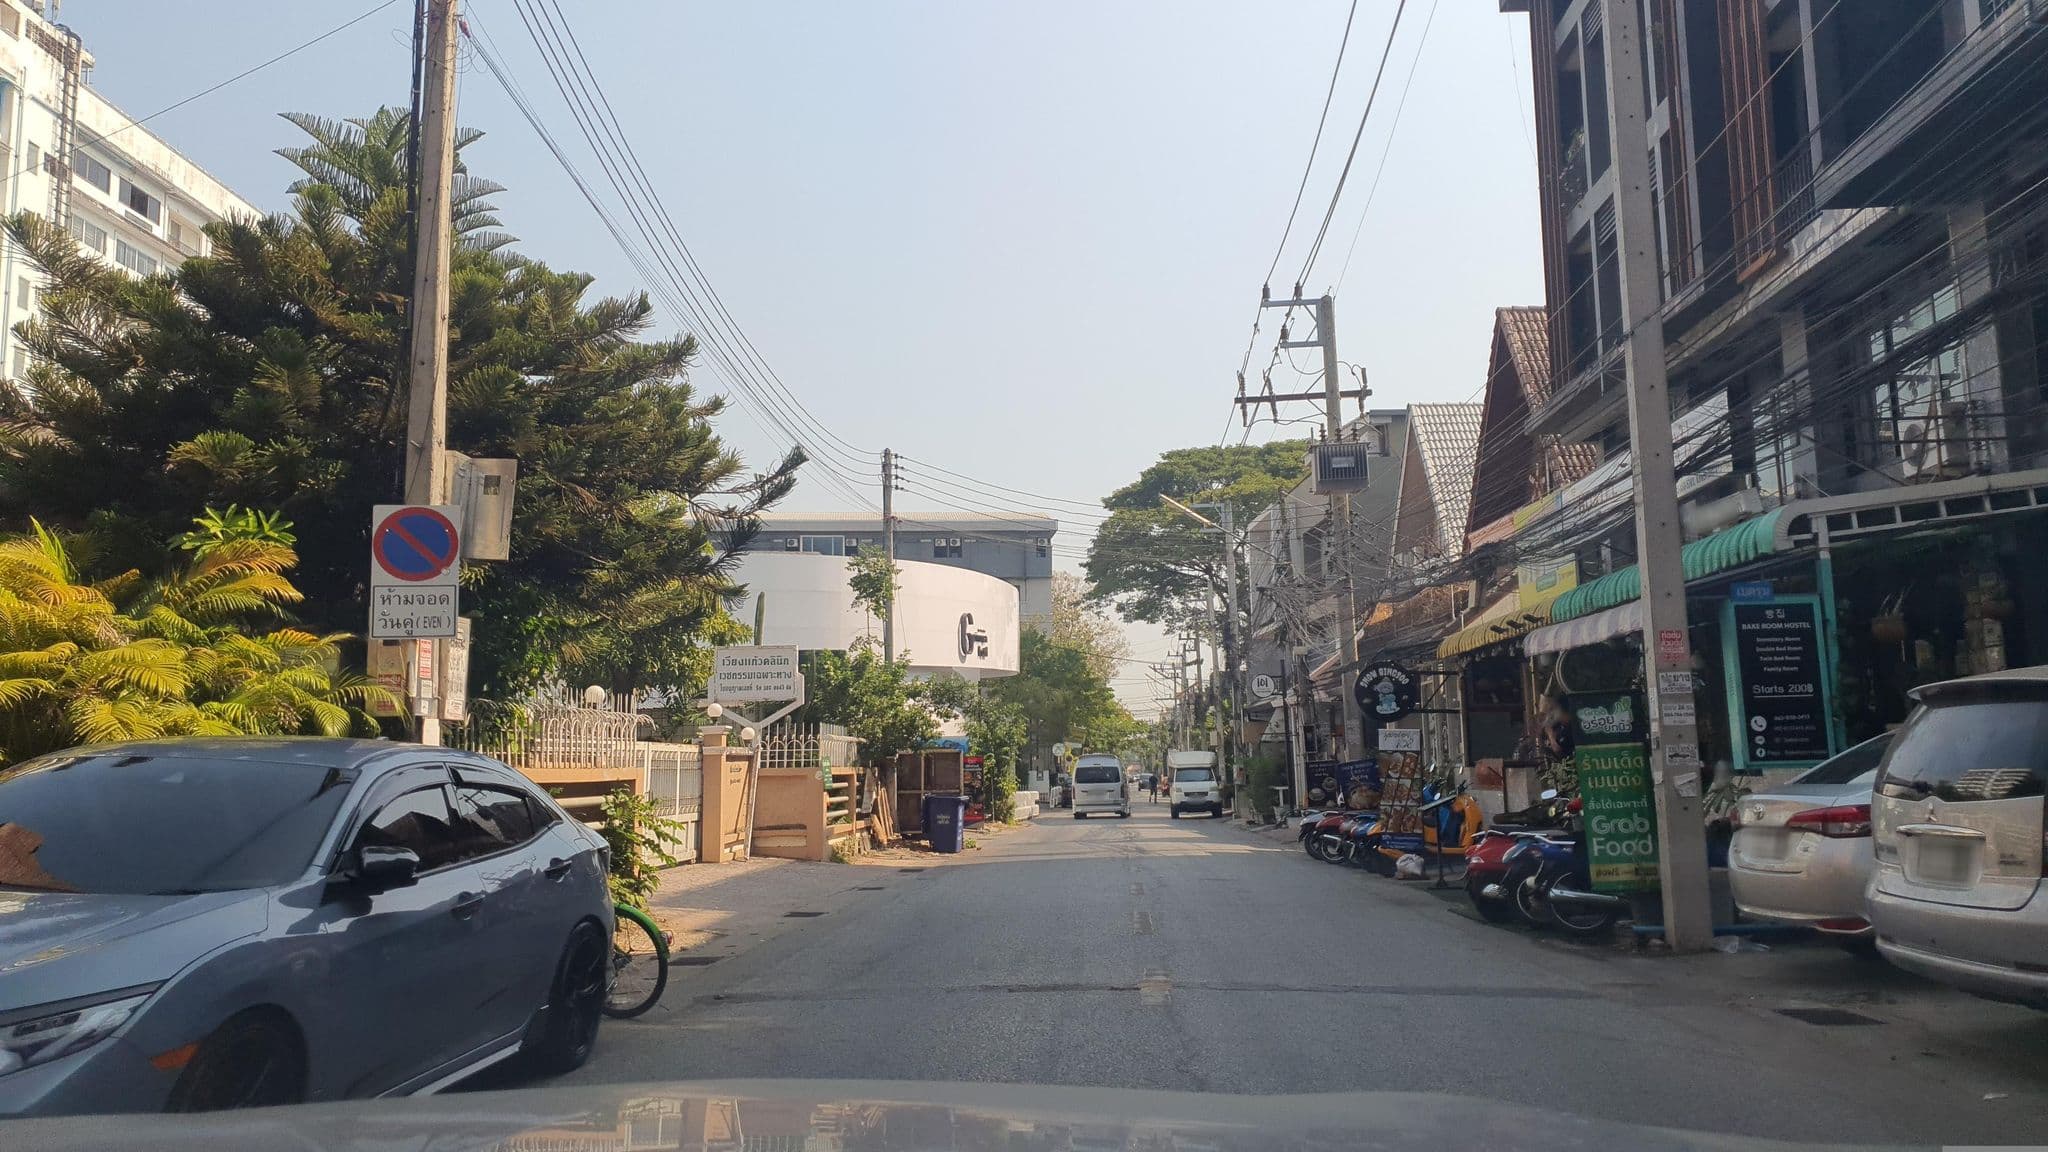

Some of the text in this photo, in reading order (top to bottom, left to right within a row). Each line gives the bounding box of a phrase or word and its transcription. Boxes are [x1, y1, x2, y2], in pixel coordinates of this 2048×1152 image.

[380, 587, 450, 606] ห้ามจอด
[378, 610, 414, 636] วันคู่
[1741, 621, 1812, 631] BAKE ROOM HOSTEL
[721, 655, 790, 666] เวียงแก้วคลินิก
[719, 671, 793, 681] เวชกรรมเฉพาะทาง
[1752, 684, 1784, 694] Starts
[1581, 750, 1645, 772] ร้านเด็ด
[1587, 771, 1642, 793] เมนูดัง
[1587, 795, 1648, 811] สั่งได้เฉพาะที่
[1591, 812, 1650, 835] Grab
[1592, 834, 1653, 857] Food
